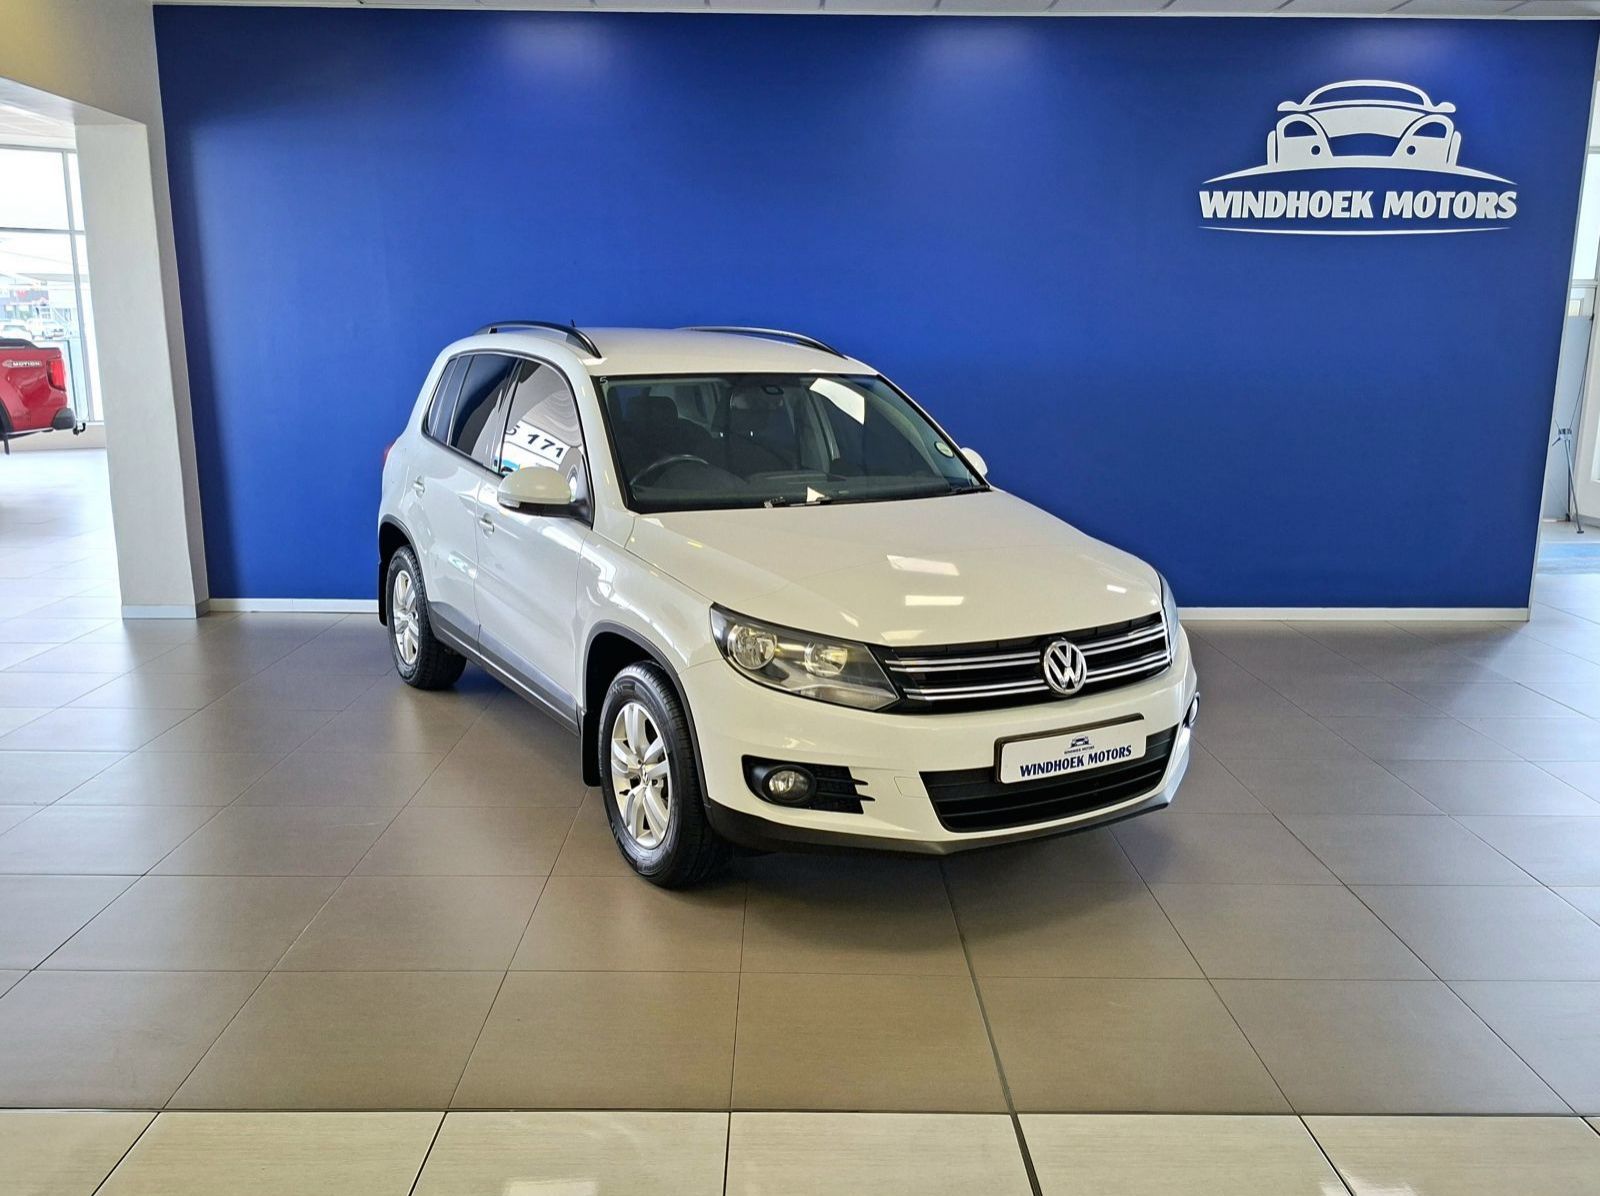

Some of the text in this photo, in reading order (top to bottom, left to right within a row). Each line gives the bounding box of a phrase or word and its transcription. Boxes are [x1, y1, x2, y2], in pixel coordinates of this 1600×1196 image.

[1199, 190, 1517, 220] WINDHOEK MOTORS
[1044, 640, 1088, 695] VW
[1019, 744, 1132, 777] WINDHOEK MOTORS
